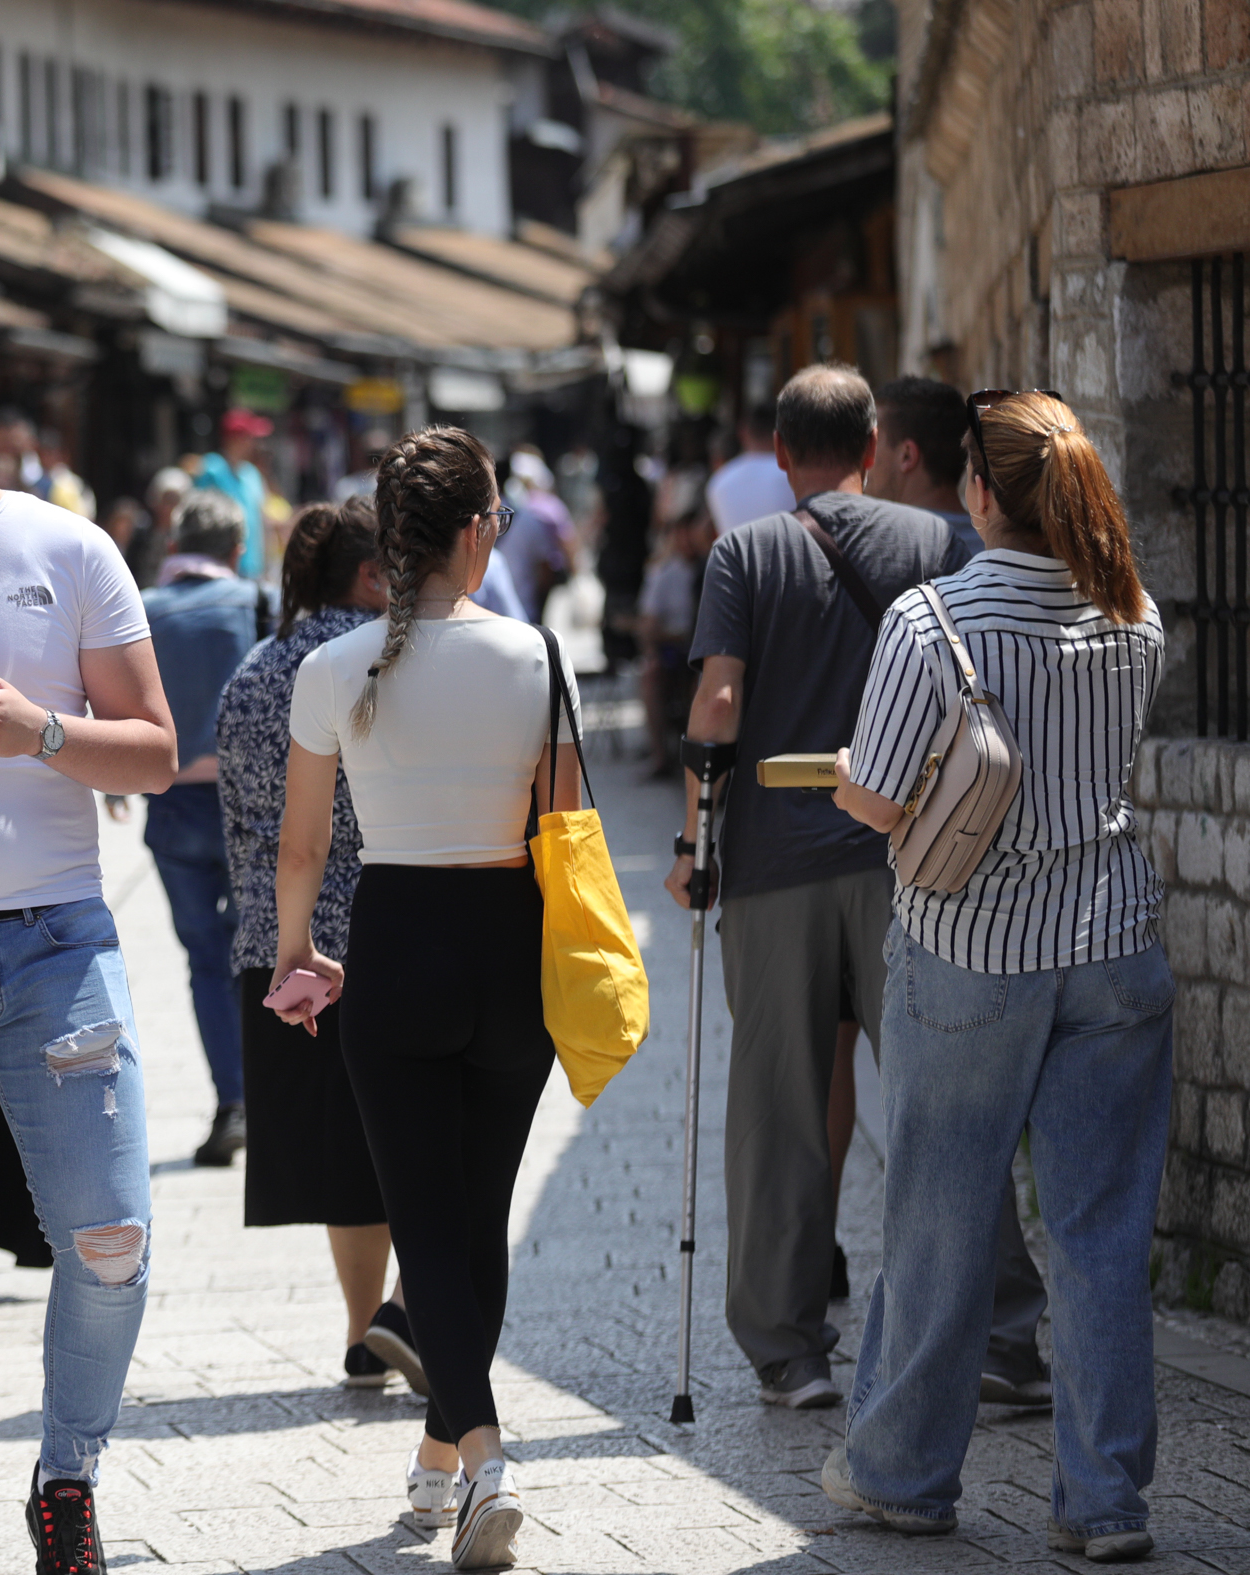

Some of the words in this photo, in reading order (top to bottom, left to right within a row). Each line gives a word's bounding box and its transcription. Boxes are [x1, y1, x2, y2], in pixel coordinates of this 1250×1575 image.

[19, 585, 35, 593] THE
[7, 591, 37, 601] NORTH
[16, 598, 39, 607] FACE
[484, 1466, 504, 1477] NIKE
[426, 1479, 445, 1488] NIKE
